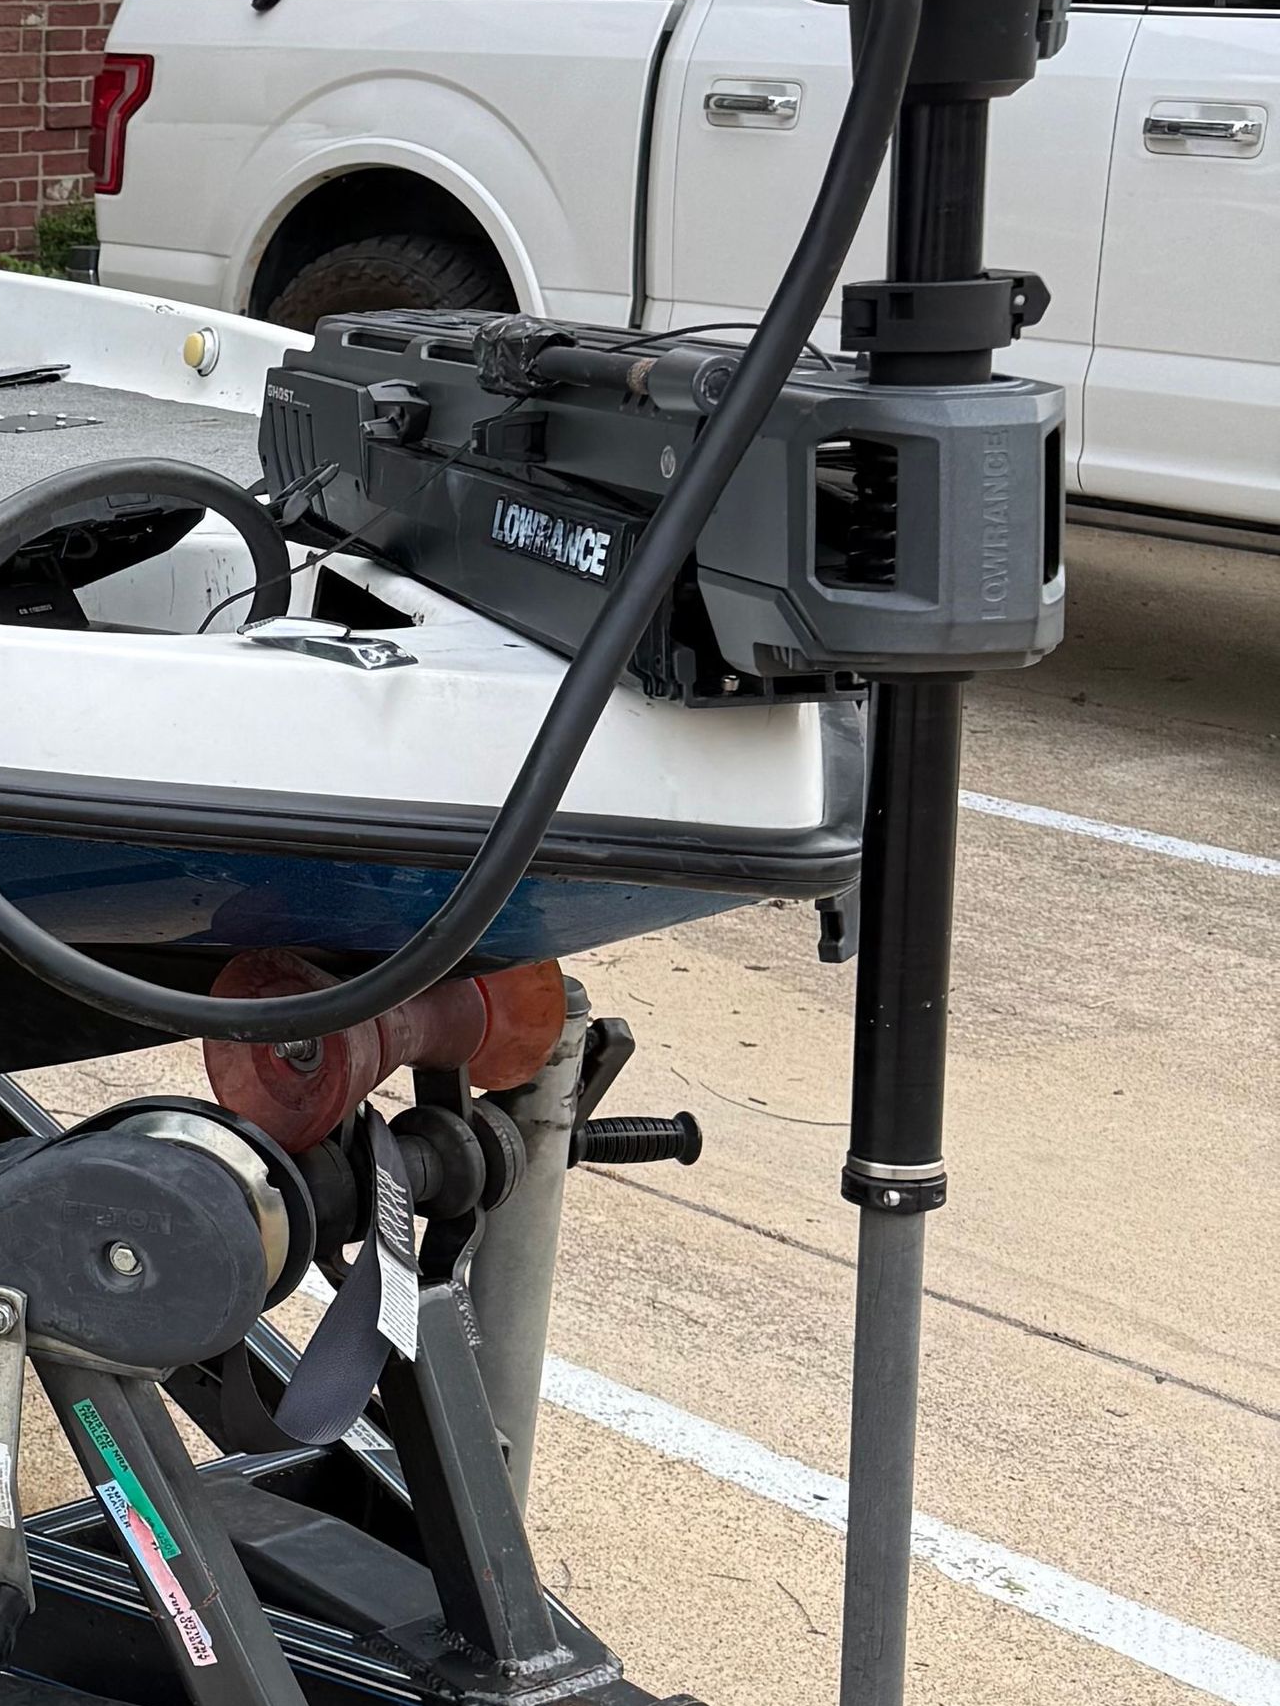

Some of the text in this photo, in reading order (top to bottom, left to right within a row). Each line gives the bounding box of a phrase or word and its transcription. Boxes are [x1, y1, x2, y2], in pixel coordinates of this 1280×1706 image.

[267, 383, 294, 404] GHOST
[491, 498, 611, 576] LOWRANCE
[981, 427, 1010, 621] LOWRANCE
[63, 1199, 175, 1237] FTON
[78, 1406, 108, 1451] TRAILER
[84, 1402, 129, 1472] AMISTAD NRA
[109, 1484, 128, 1513] AMIS
[168, 1592, 184, 1616] NRA
